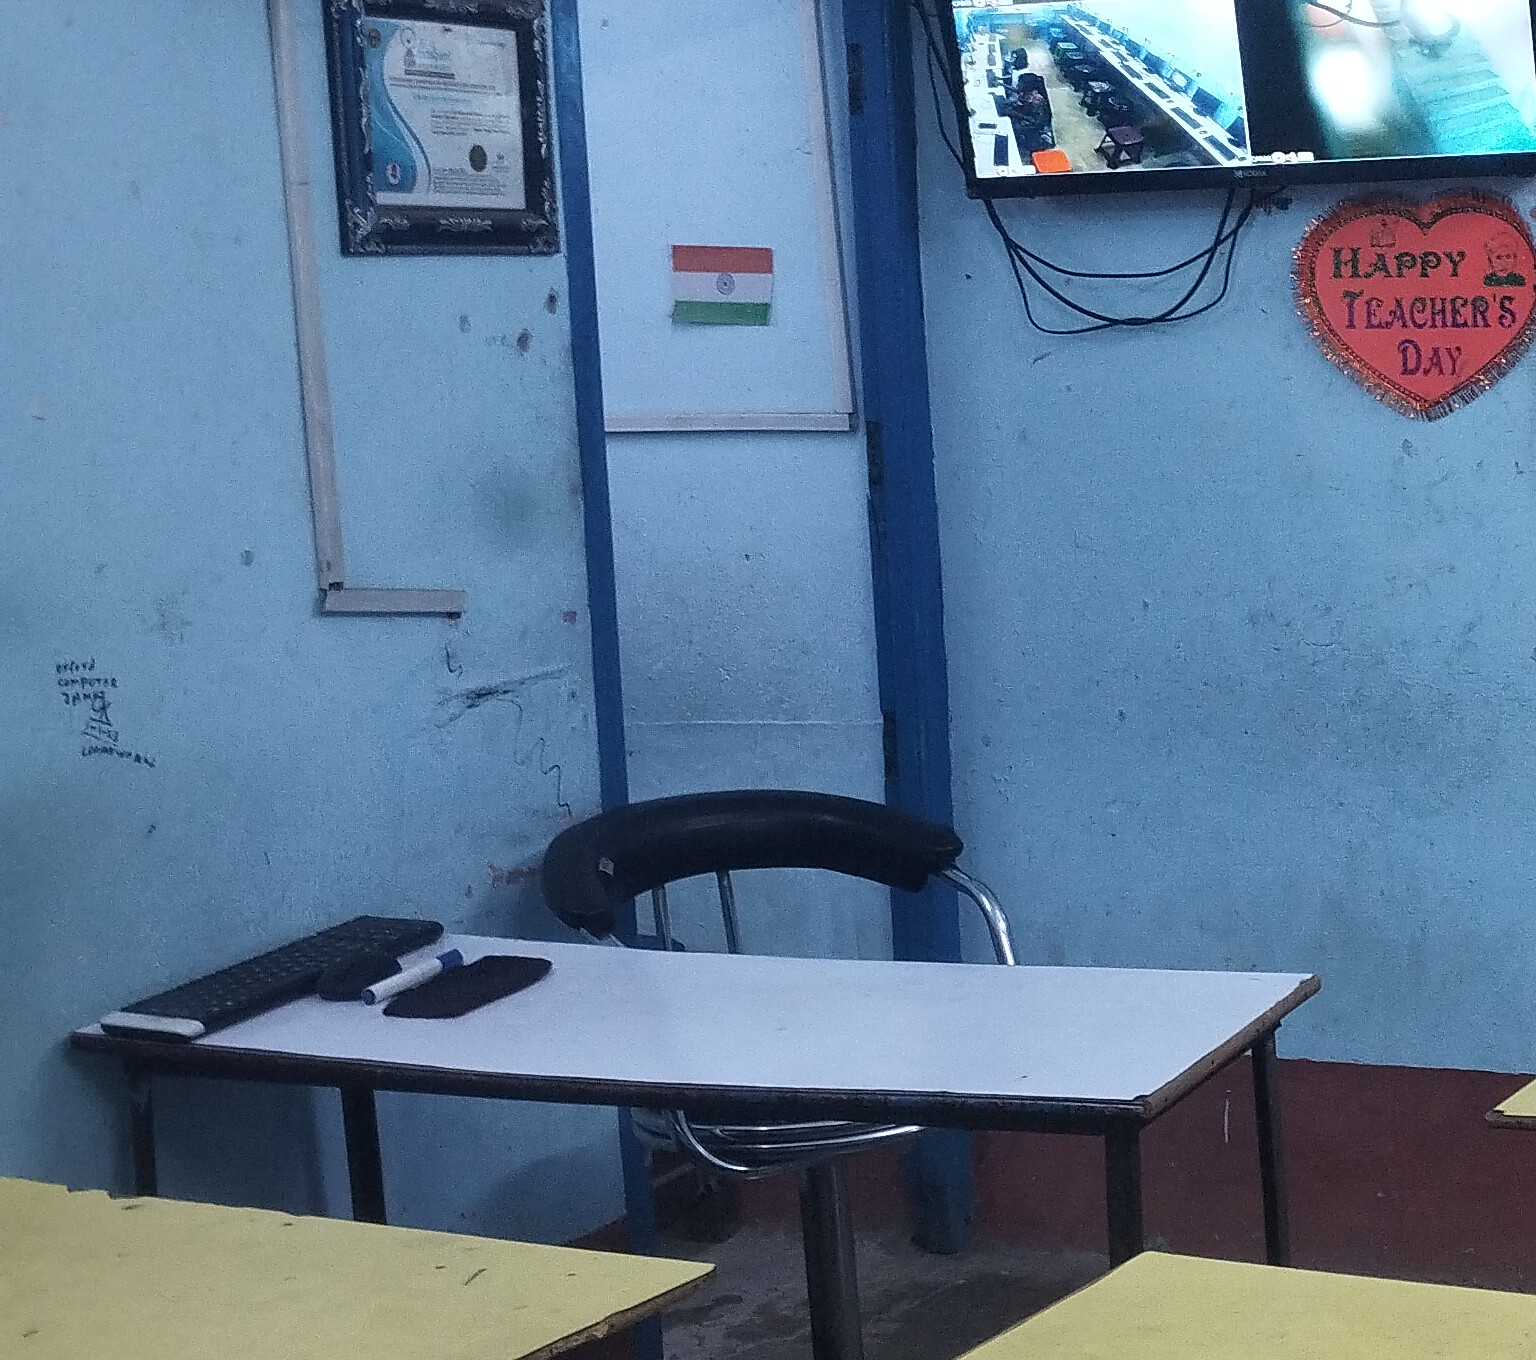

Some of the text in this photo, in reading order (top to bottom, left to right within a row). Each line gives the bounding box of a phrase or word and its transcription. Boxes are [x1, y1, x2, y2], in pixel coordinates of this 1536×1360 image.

[1330, 246, 1466, 279] HAPPY
[1341, 290, 1516, 329] TEACHER'S
[1397, 338, 1463, 376] DAY
